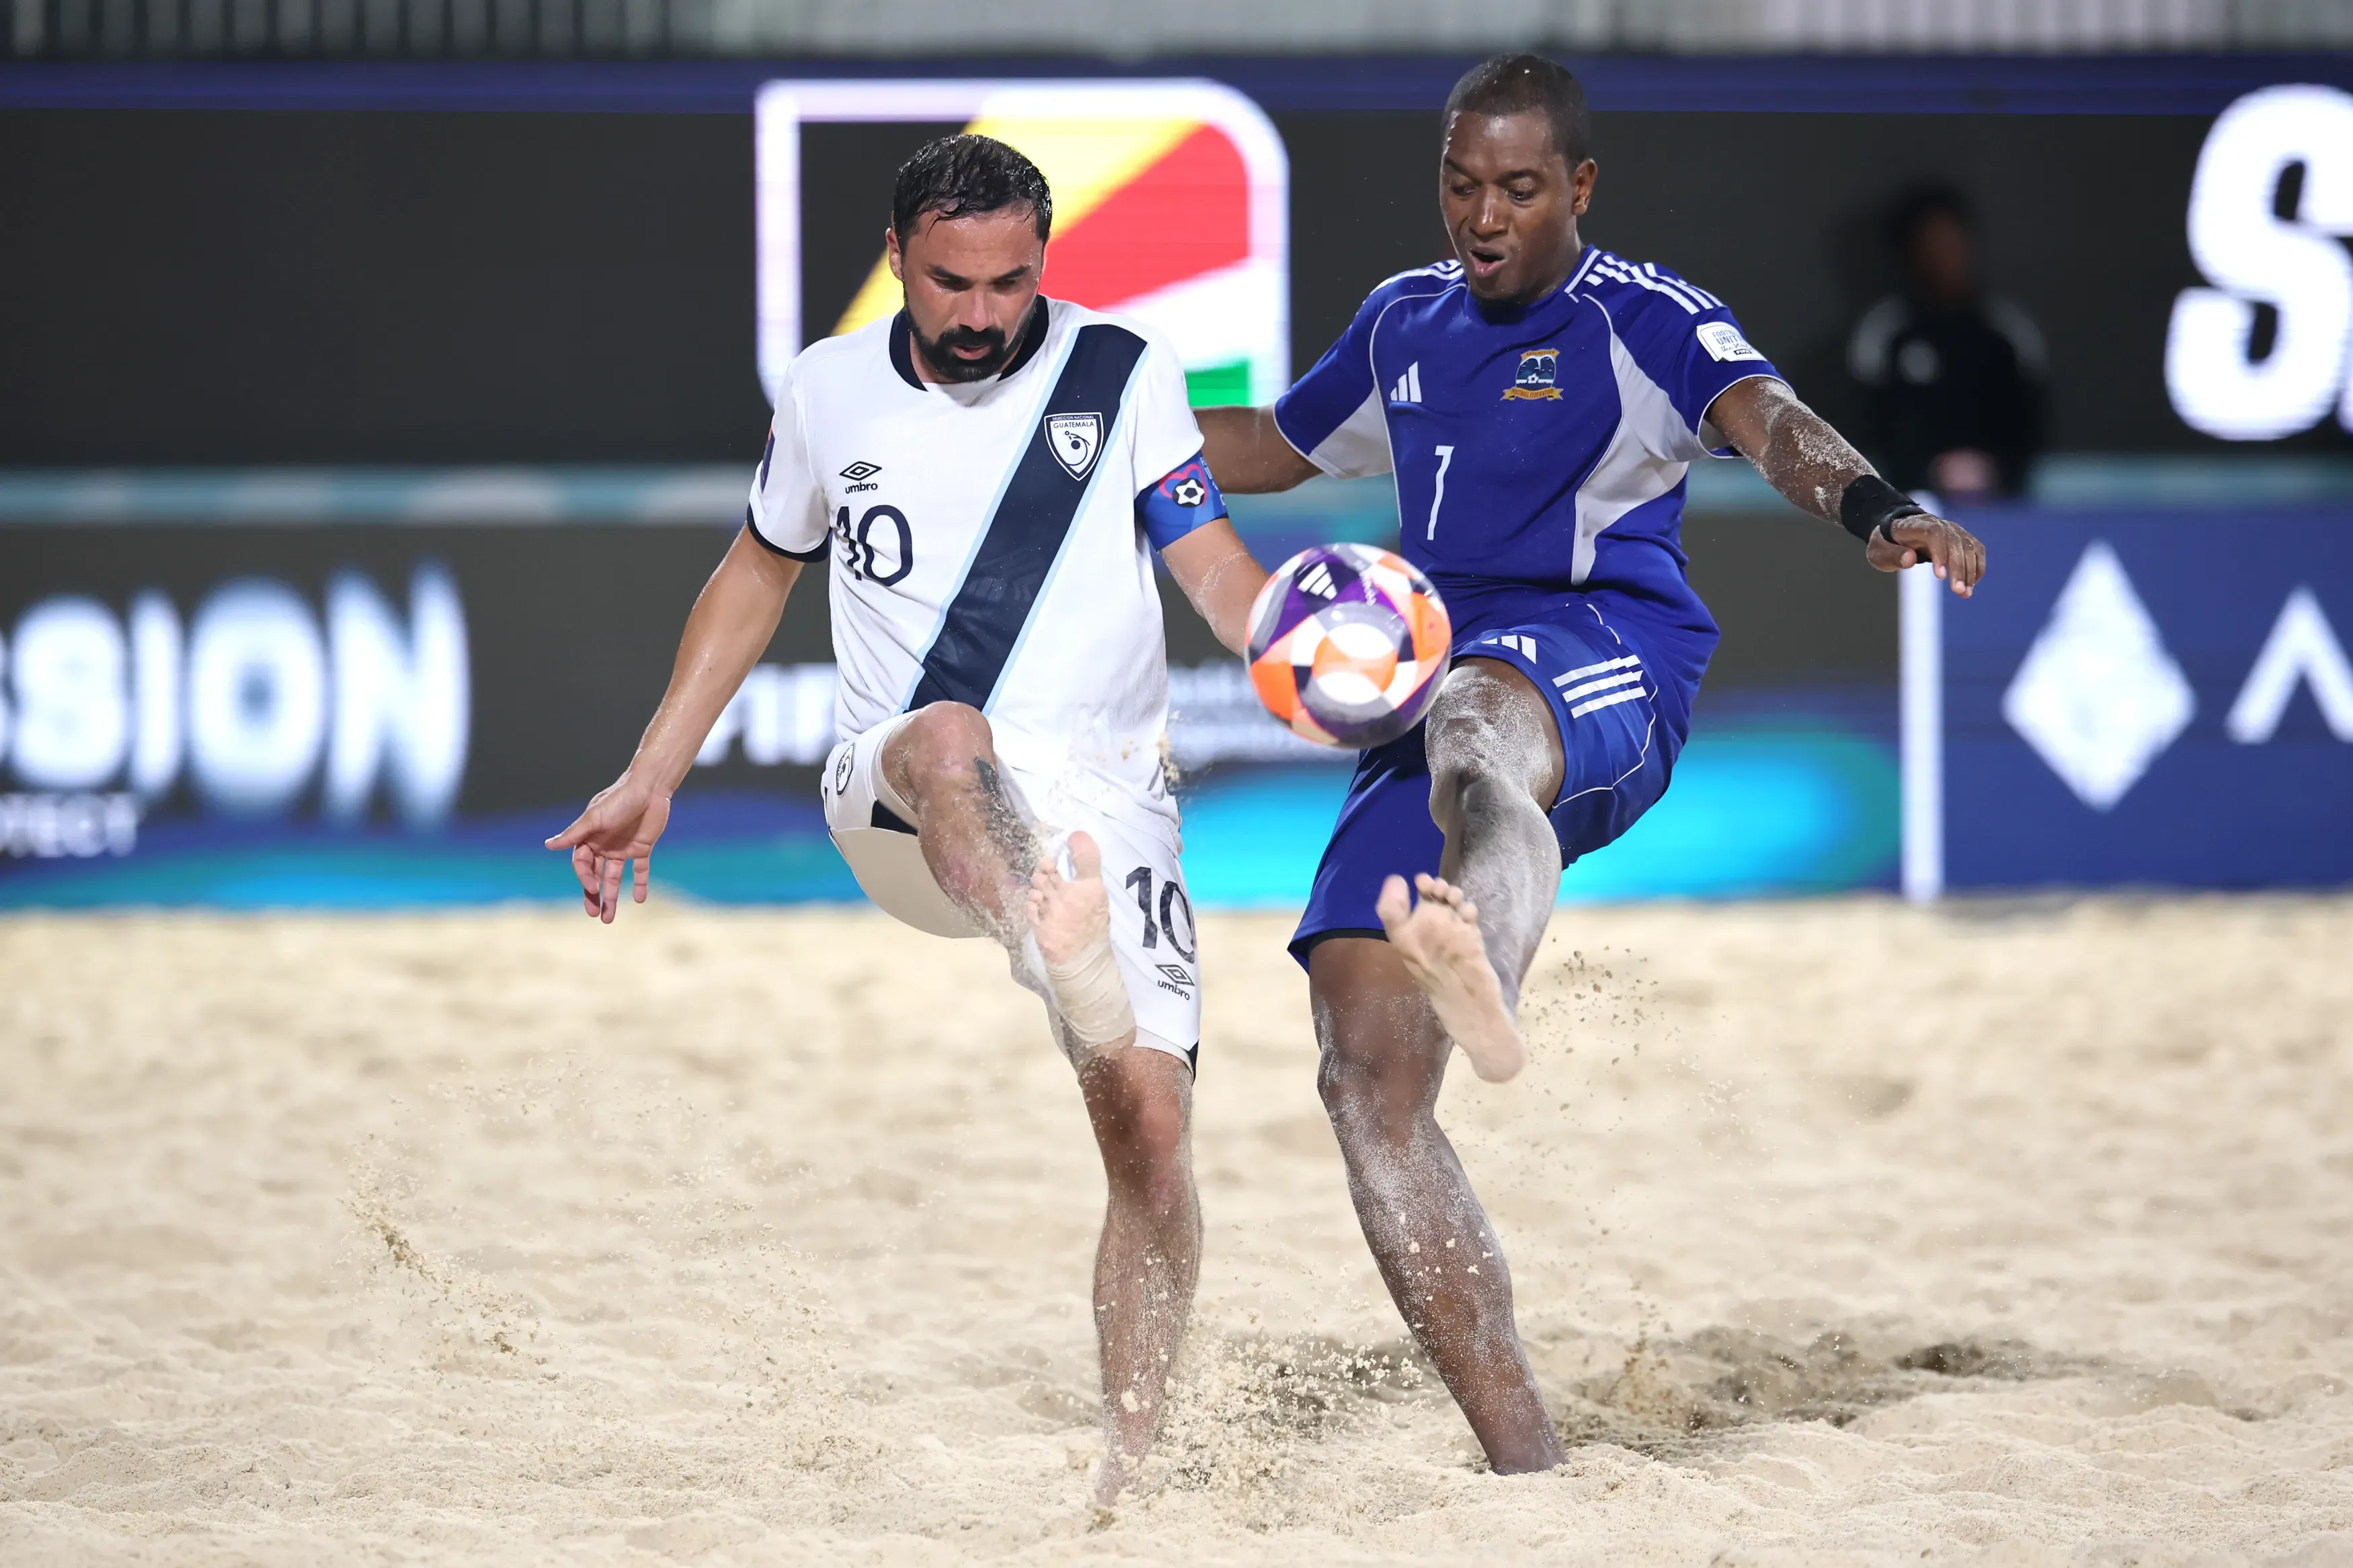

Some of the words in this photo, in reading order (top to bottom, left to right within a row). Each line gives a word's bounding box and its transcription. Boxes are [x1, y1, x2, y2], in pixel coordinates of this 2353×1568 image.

[2162, 82, 2353, 441] S
[1053, 421, 1094, 429] GUATEMALA
[845, 482, 878, 494] umbro
[1427, 446, 1455, 540] 7
[836, 505, 913, 587] 10
[0, 554, 472, 825] SION
[1125, 866, 1195, 964] 10
[1157, 980, 1190, 1001] umbro
